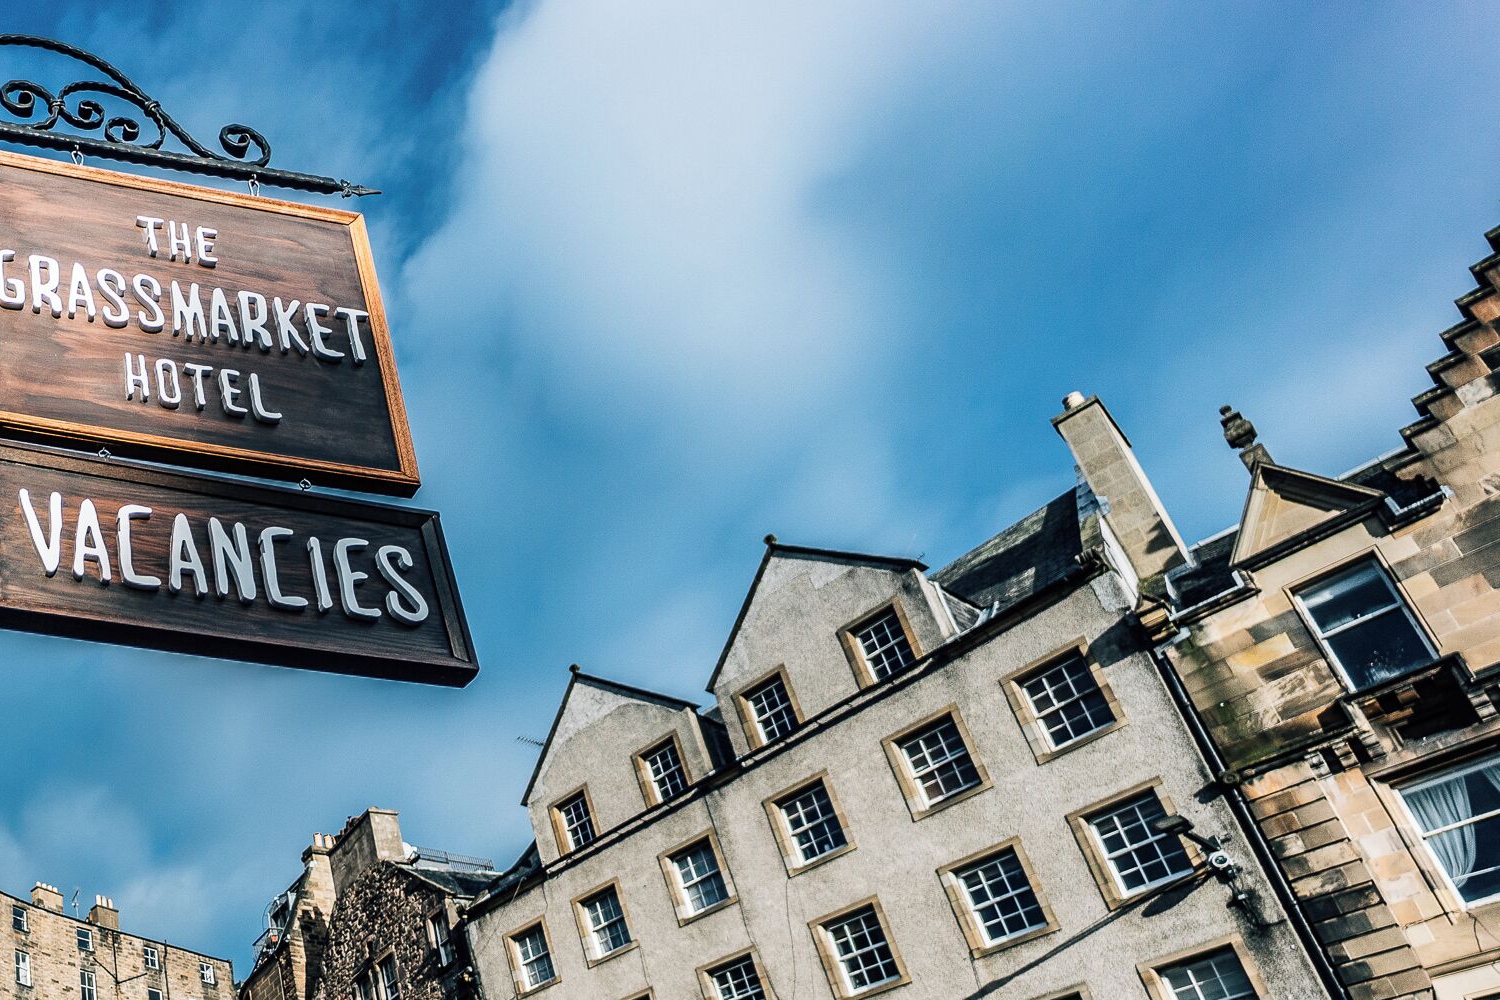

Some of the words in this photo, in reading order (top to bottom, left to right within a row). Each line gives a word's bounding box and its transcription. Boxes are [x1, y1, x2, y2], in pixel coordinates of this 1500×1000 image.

[135, 214, 219, 268] THE
[123, 352, 284, 426] HOTEL
[18, 487, 430, 626] VACANCIES
